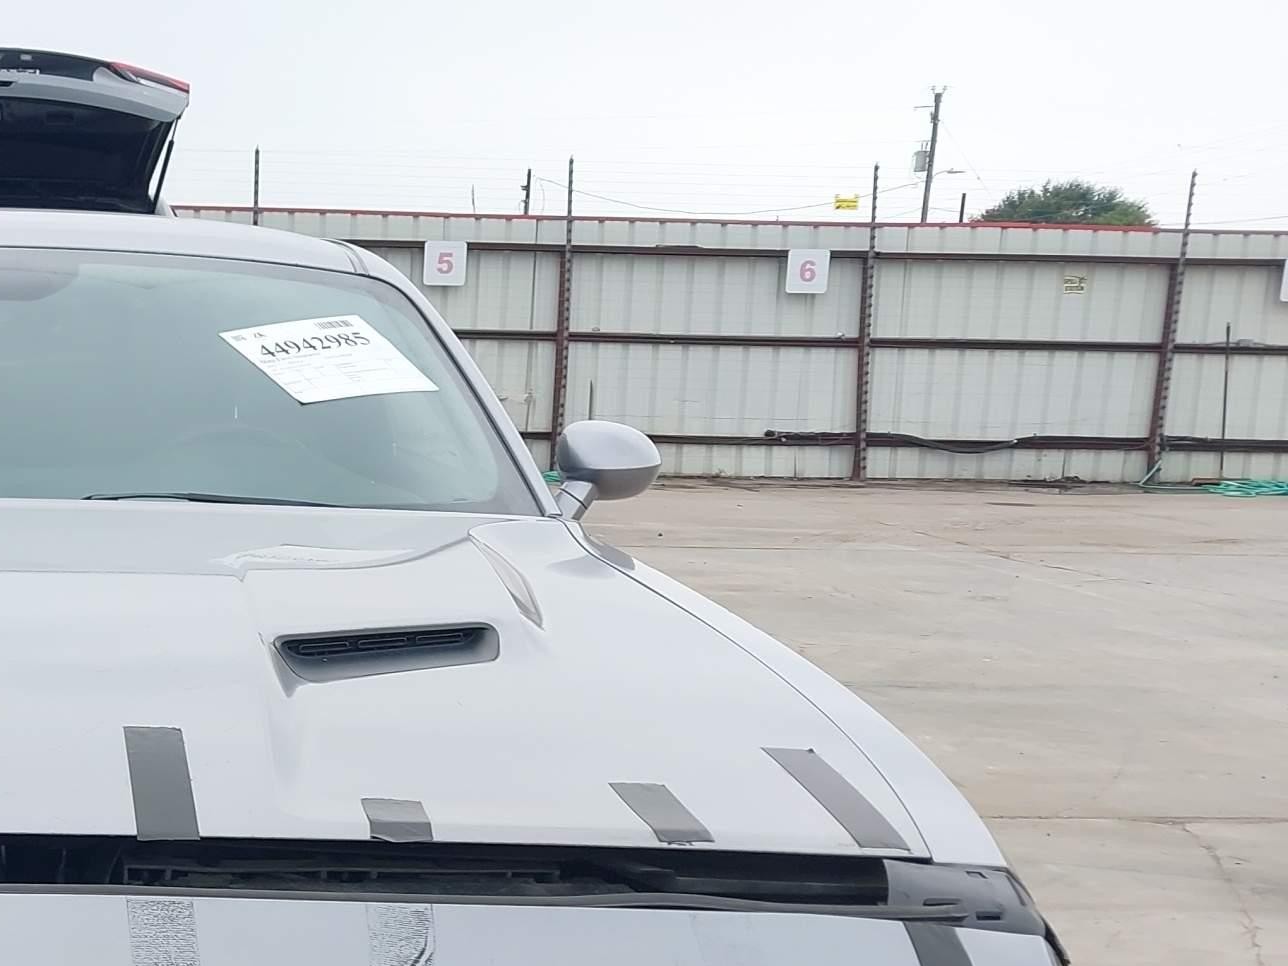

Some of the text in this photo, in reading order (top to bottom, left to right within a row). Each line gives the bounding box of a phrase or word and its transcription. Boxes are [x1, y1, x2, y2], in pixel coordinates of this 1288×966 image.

[436, 252, 454, 274] 5
[799, 260, 817, 282] 6
[260, 332, 371, 357] 44942985
